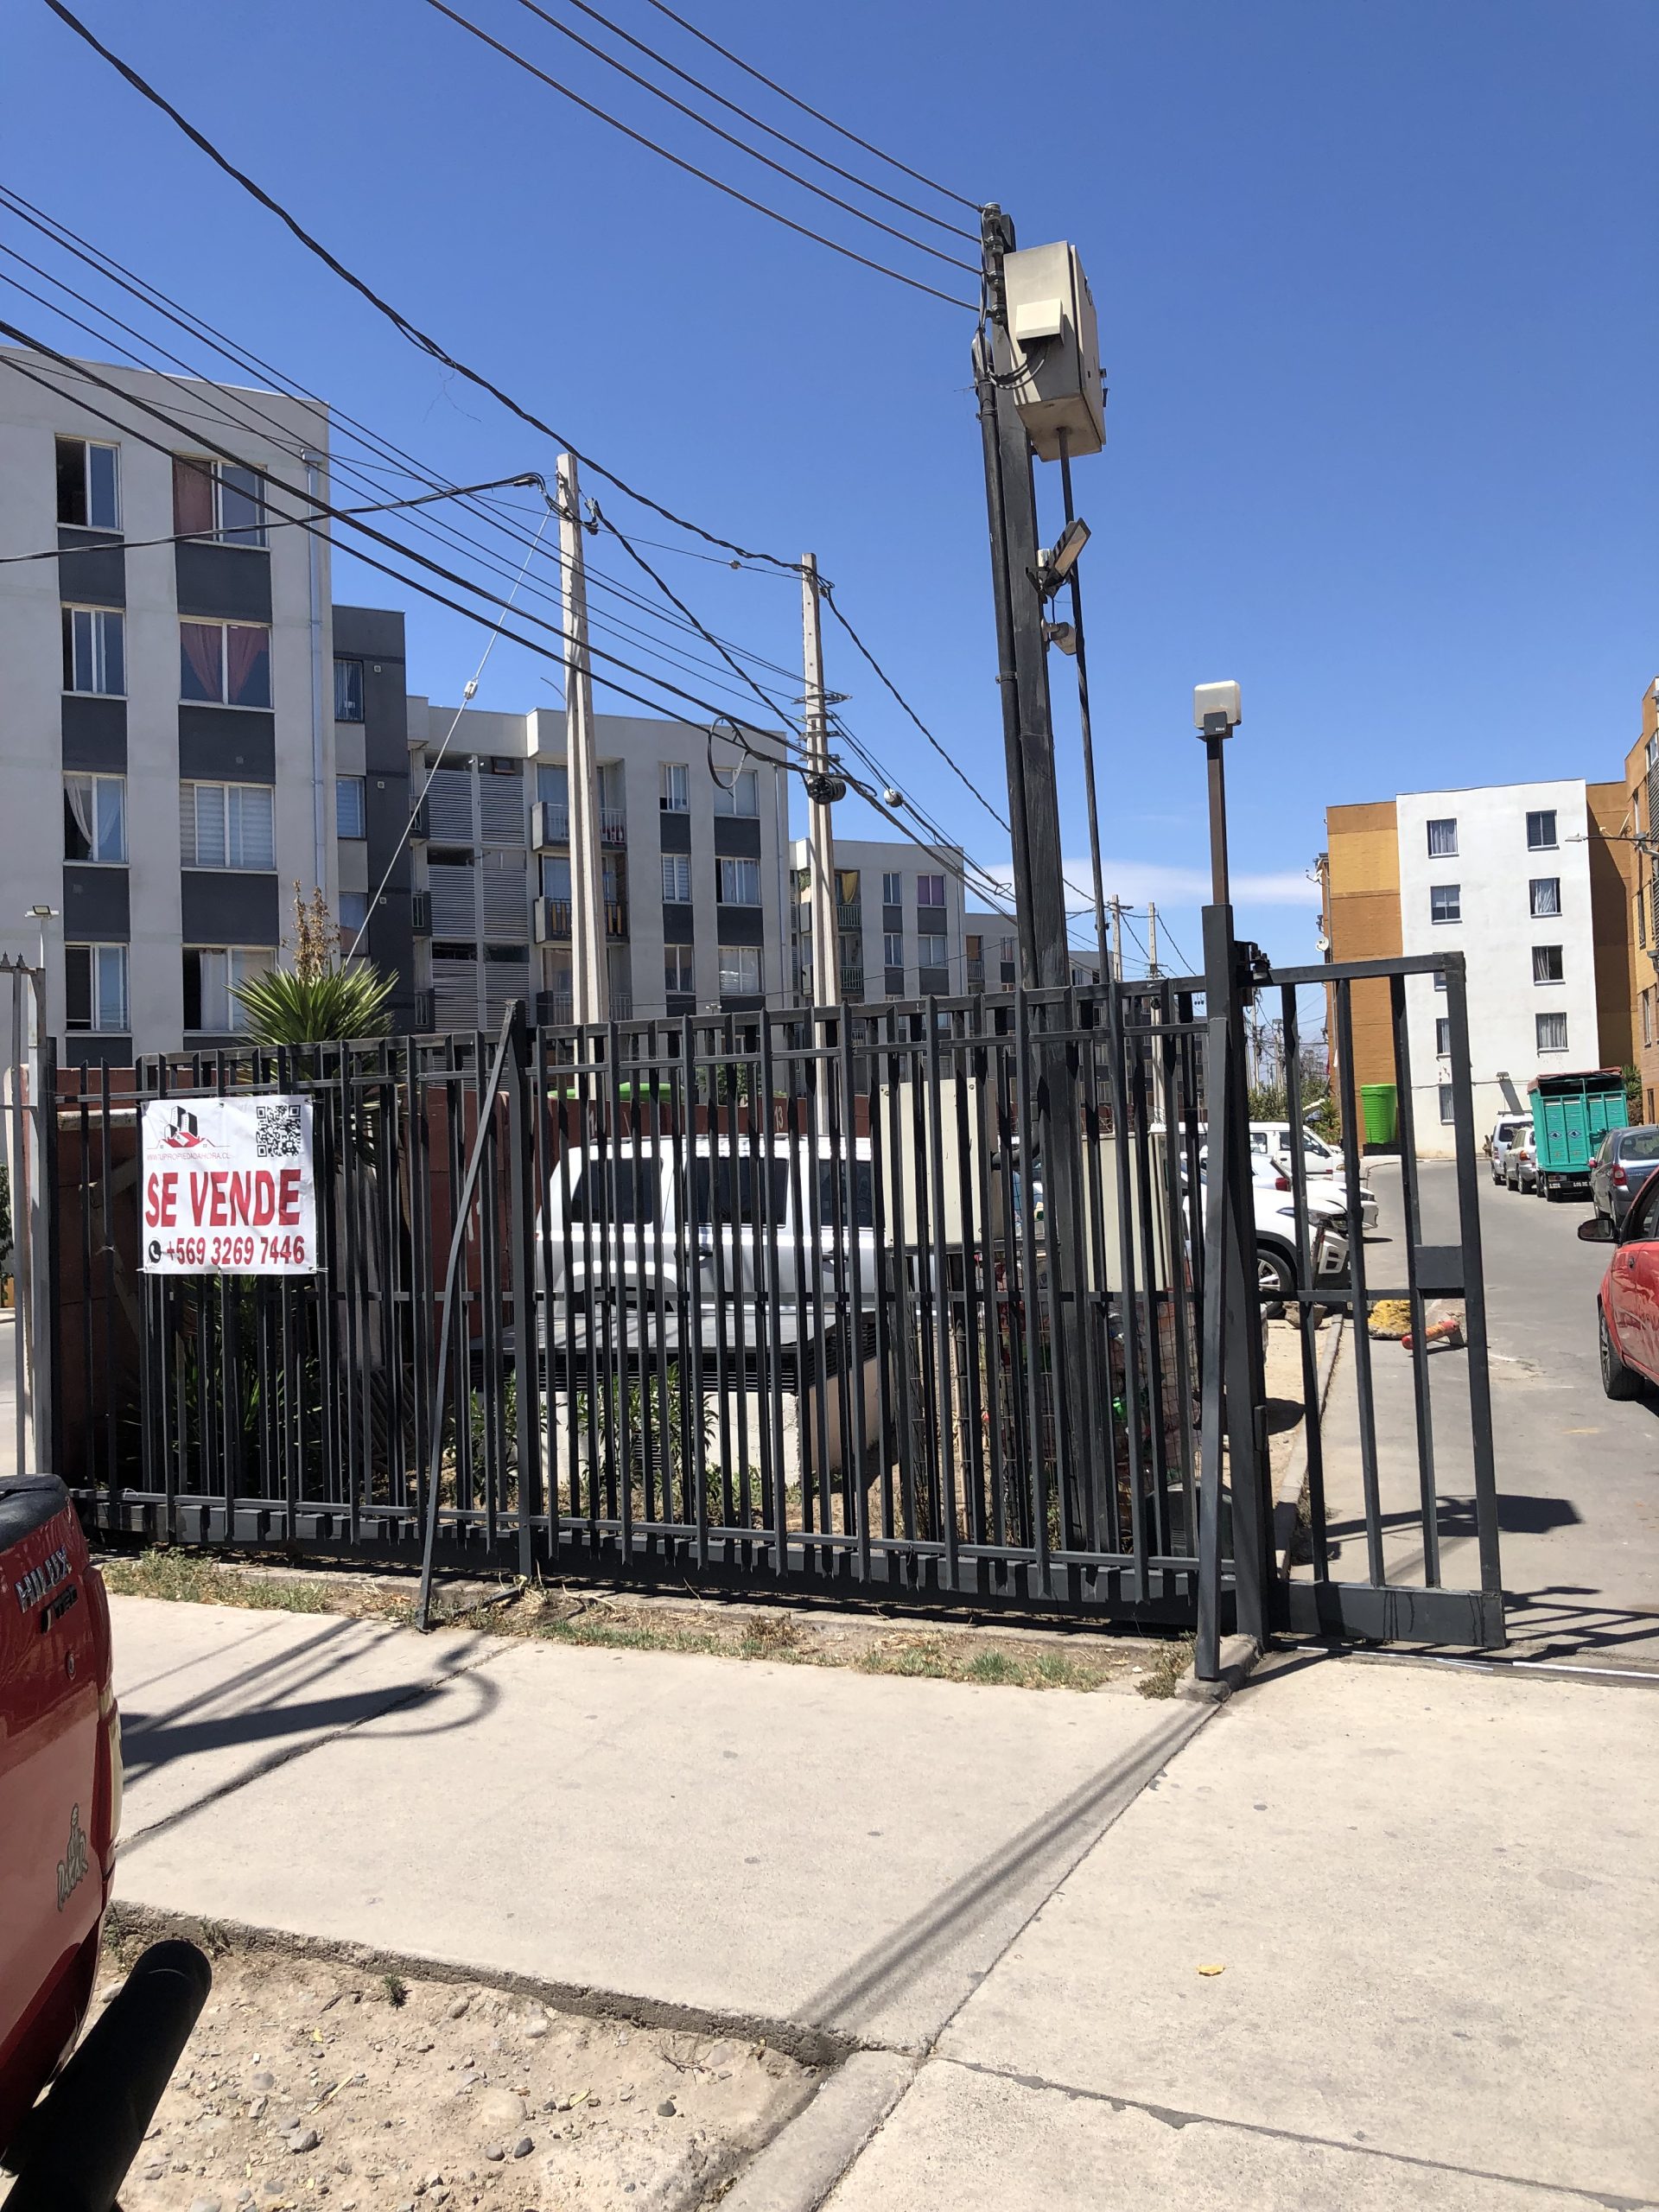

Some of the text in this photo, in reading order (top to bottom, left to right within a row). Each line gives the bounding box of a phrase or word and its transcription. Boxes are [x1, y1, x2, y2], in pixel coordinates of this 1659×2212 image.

[774, 1105, 784, 1133] 13
[145, 1169, 302, 1228] SE VENDE
[166, 1235, 305, 1265] +569 3269 7446
[16, 1544, 72, 1613] HILUX
[57, 1834, 88, 1912] DAKAR
